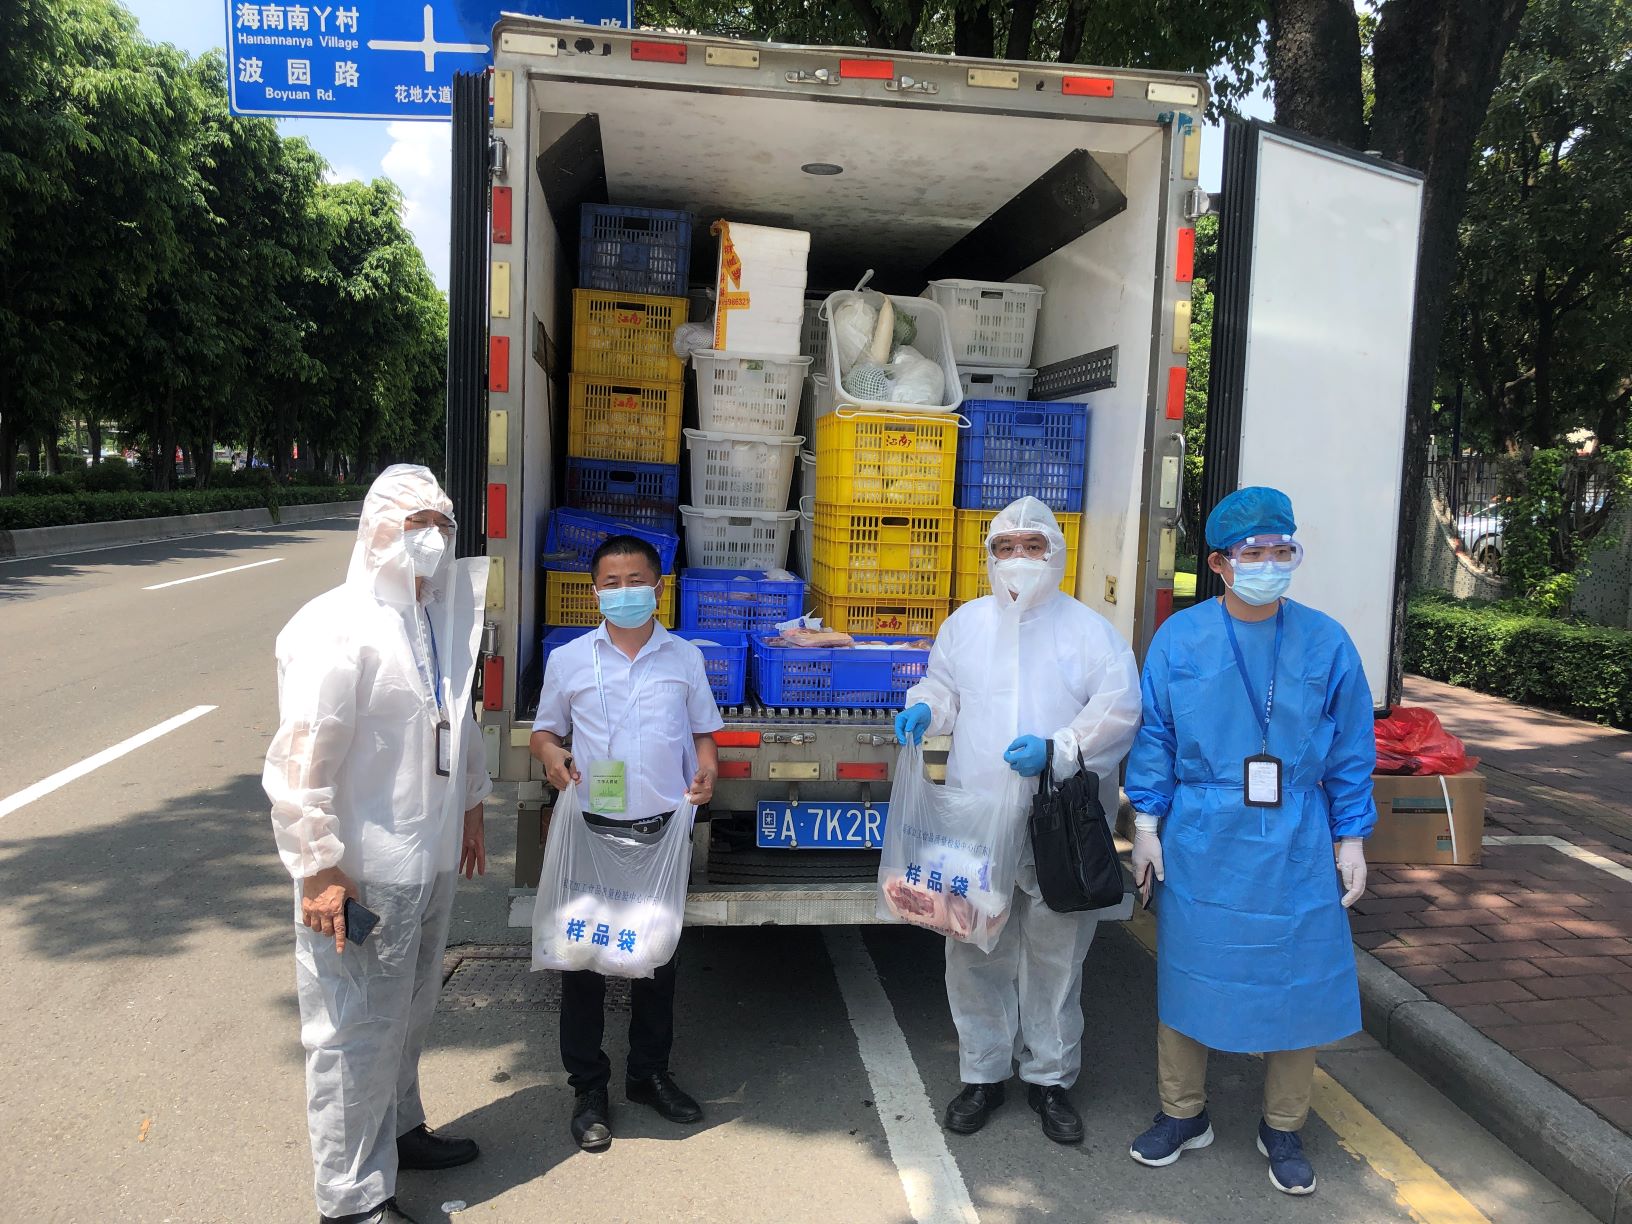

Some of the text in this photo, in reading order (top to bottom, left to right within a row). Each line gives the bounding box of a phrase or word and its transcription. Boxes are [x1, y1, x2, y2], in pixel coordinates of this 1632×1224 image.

[236, 3, 359, 33] 海南南丫村
[238, 33, 359, 50] Hainannanya Village
[238, 57, 360, 88] 波园路
[265, 87, 336, 101] Boyuan Rd.
[394, 85, 452, 104] 花地大道
[905, 862, 969, 899] 样品袋
[566, 918, 637, 954] 样品袋
